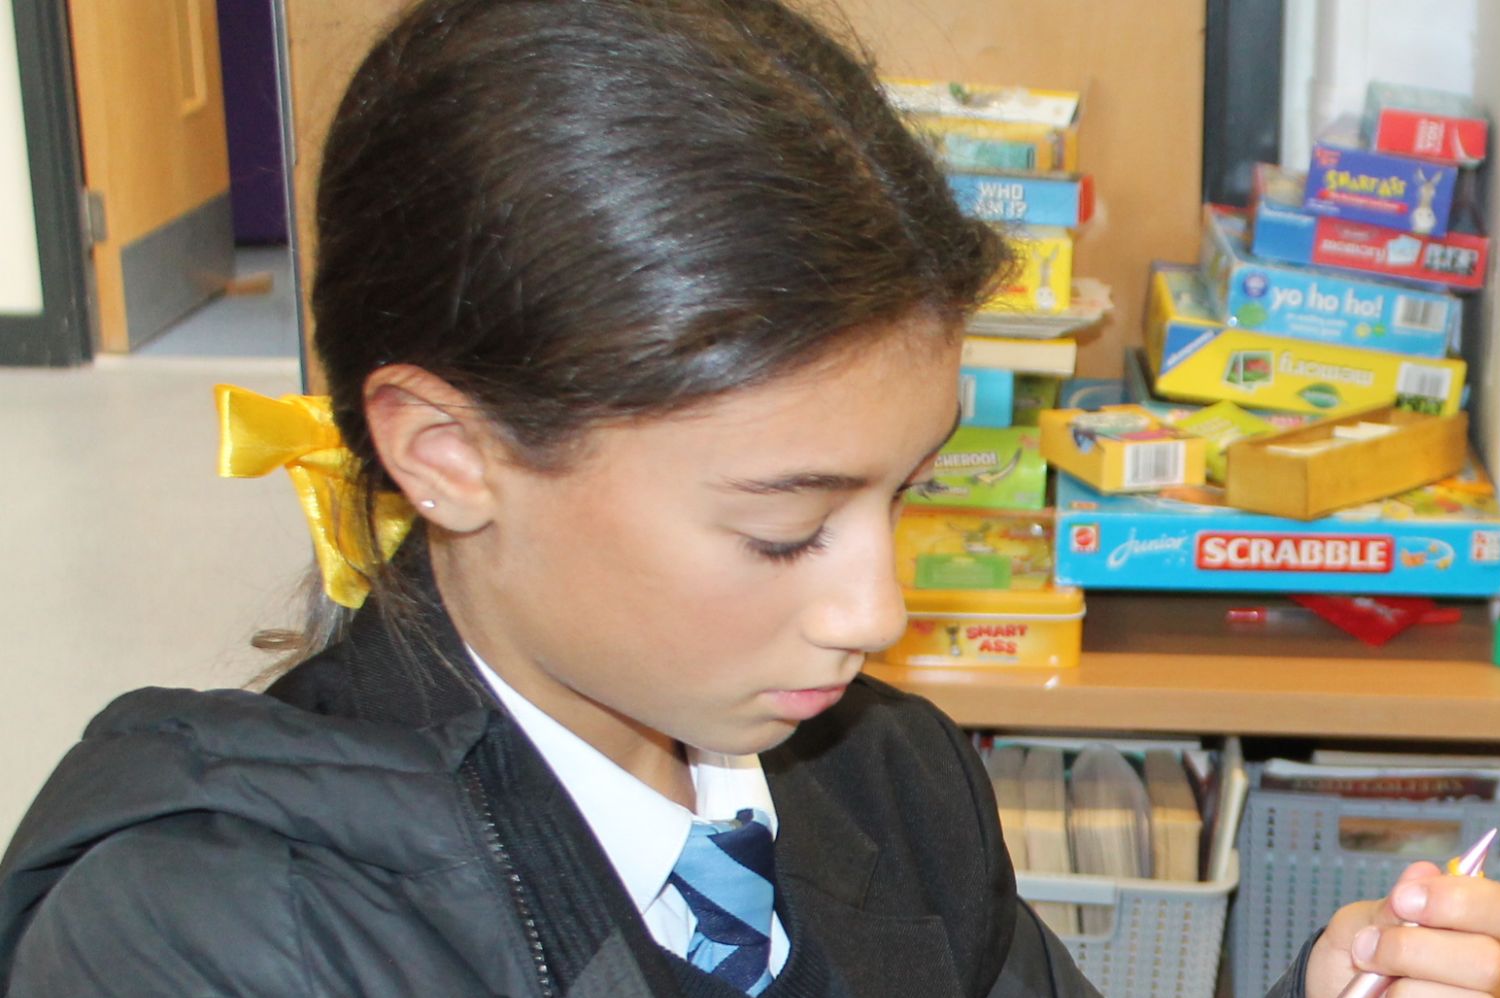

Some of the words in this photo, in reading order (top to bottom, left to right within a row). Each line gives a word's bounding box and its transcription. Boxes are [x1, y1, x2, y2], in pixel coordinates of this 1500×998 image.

[980, 182, 1024, 200] WHO
[1325, 169, 1377, 194] SMART
[1378, 174, 1407, 198] ASS
[1271, 286, 1304, 311] yo
[1306, 281, 1339, 312] ho
[1343, 287, 1385, 319] ho!
[1278, 350, 1374, 388] memory
[1107, 528, 1190, 569] Junior
[1203, 537, 1387, 568] SCRABBLE
[966, 624, 1028, 640] SMART
[979, 640, 1017, 655] ASS
